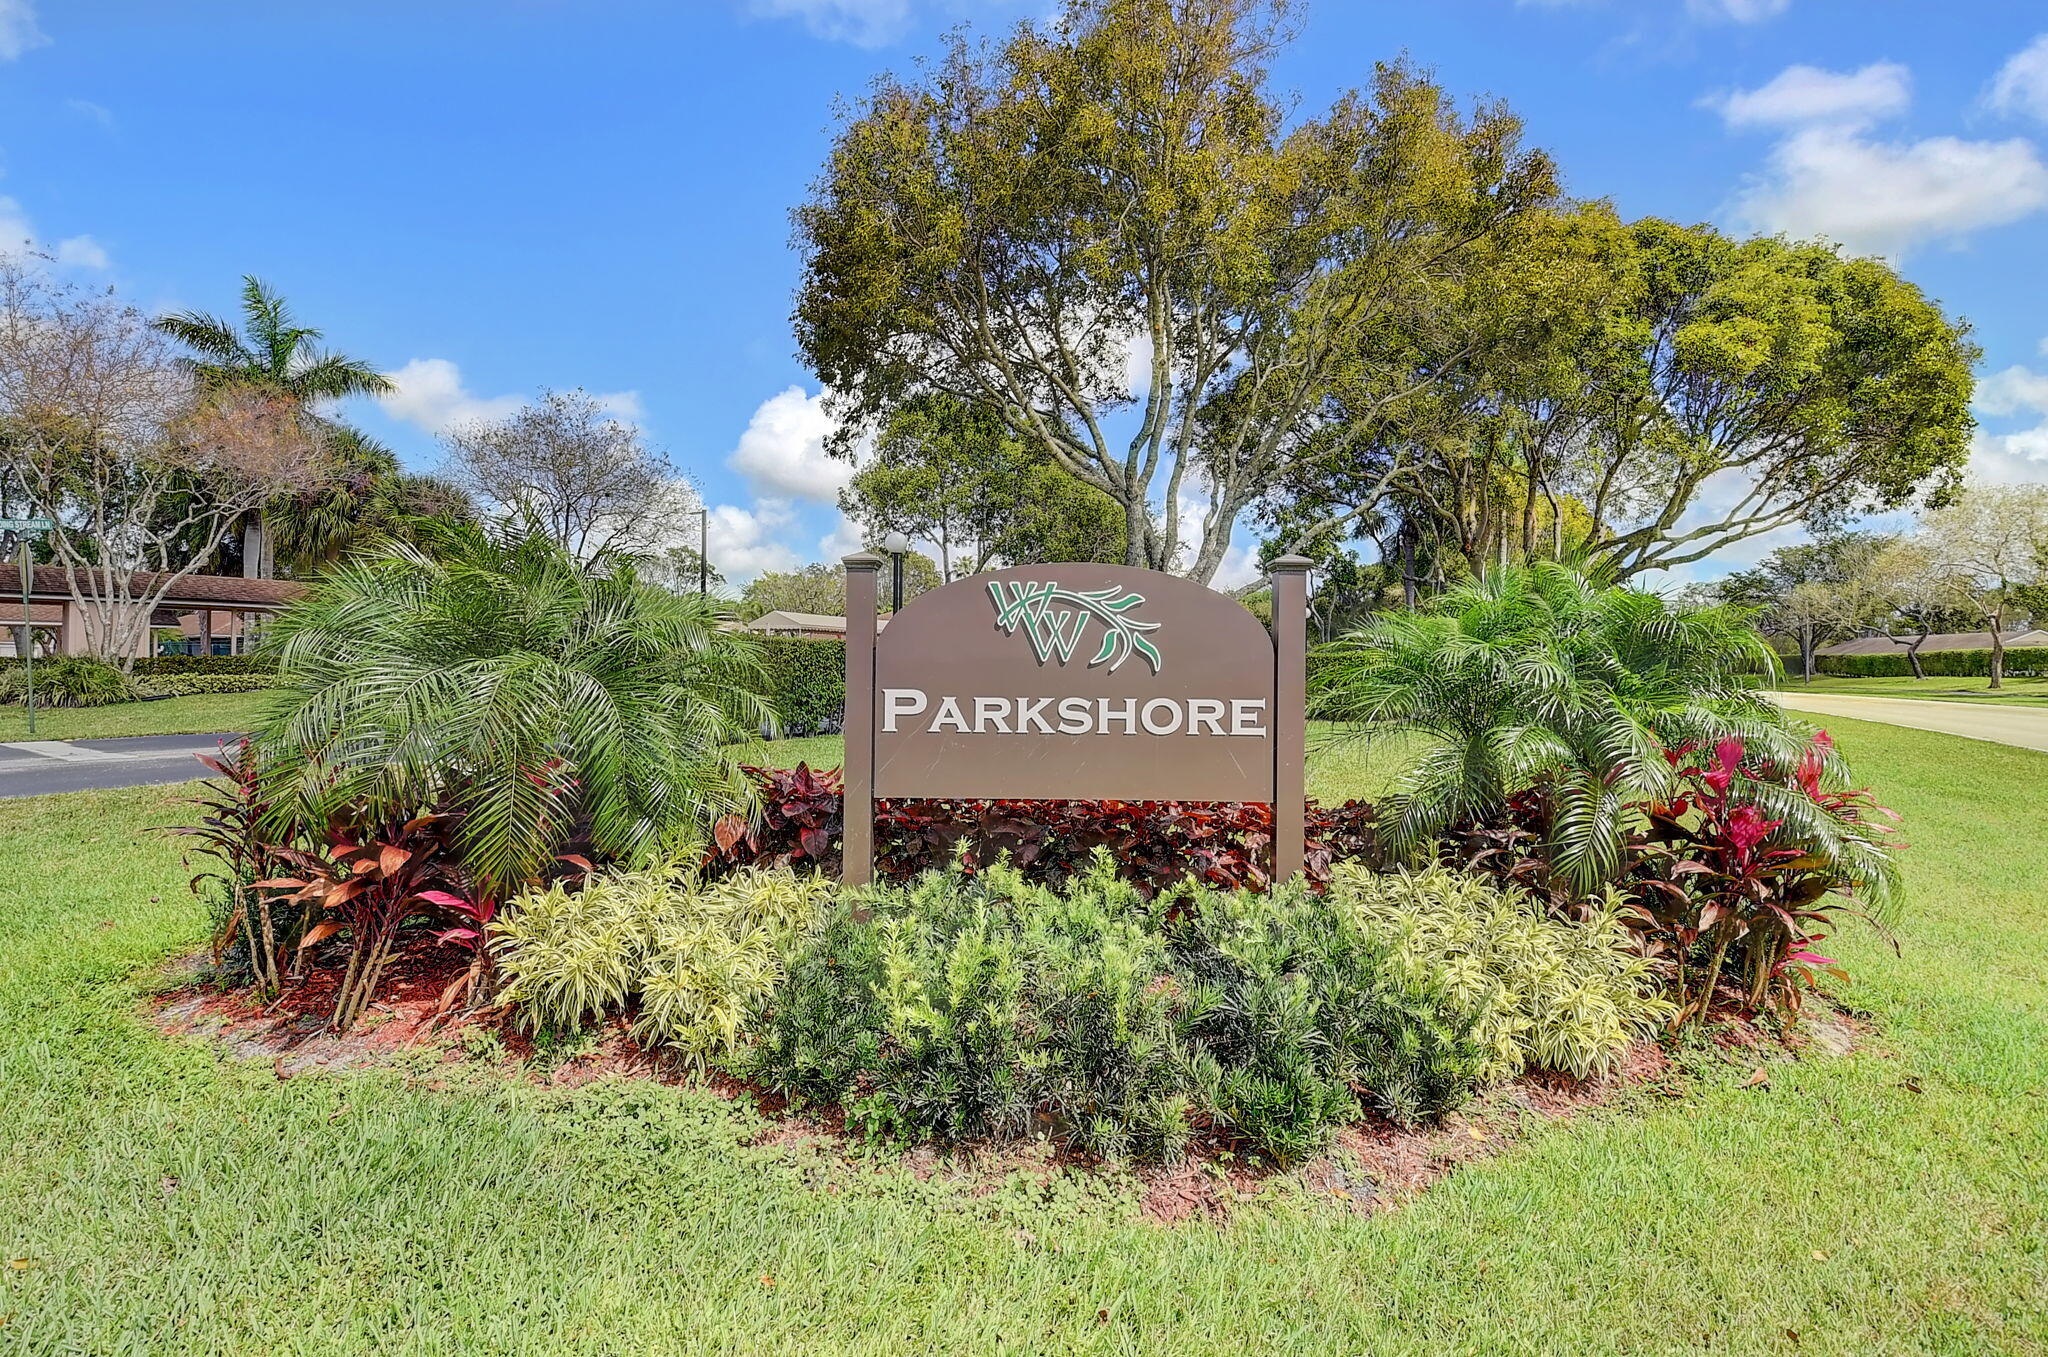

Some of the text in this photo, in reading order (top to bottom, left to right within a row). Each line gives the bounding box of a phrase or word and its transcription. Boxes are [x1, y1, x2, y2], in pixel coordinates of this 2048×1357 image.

[14, 520, 41, 529] STREAM
[41, 520, 51, 529] LN
[881, 688, 1267, 739] PARKSHORE
